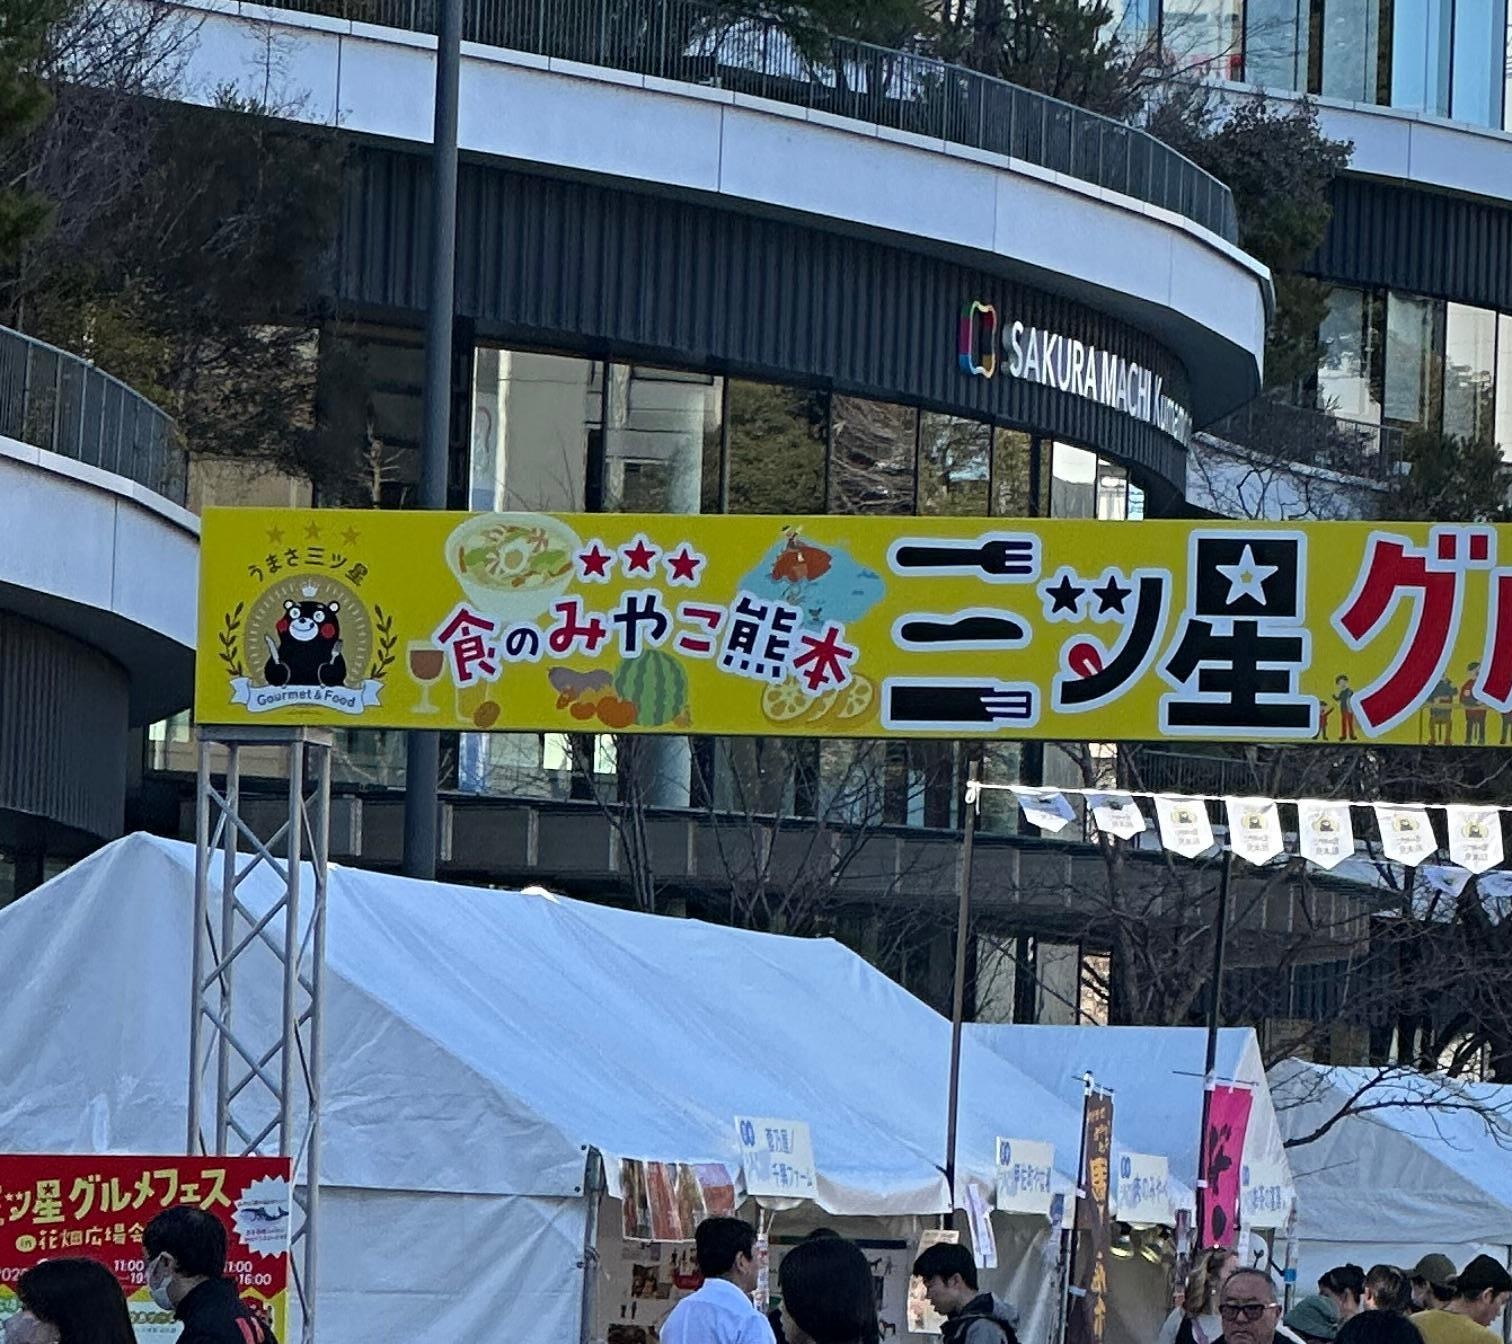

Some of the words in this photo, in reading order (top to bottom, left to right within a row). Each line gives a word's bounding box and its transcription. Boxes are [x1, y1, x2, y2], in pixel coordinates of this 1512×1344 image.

[1009, 320, 1098, 401] SAKURA
[1100, 350, 1152, 422] MACHI
[247, 546, 369, 587] うまさ三ツ星
[437, 594, 855, 691] 食のみやこ熊本
[0, 1168, 232, 1226] ツ星グルメフェス
[113, 1259, 145, 1272] 11:00
[239, 1274, 272, 1286] 16:00
